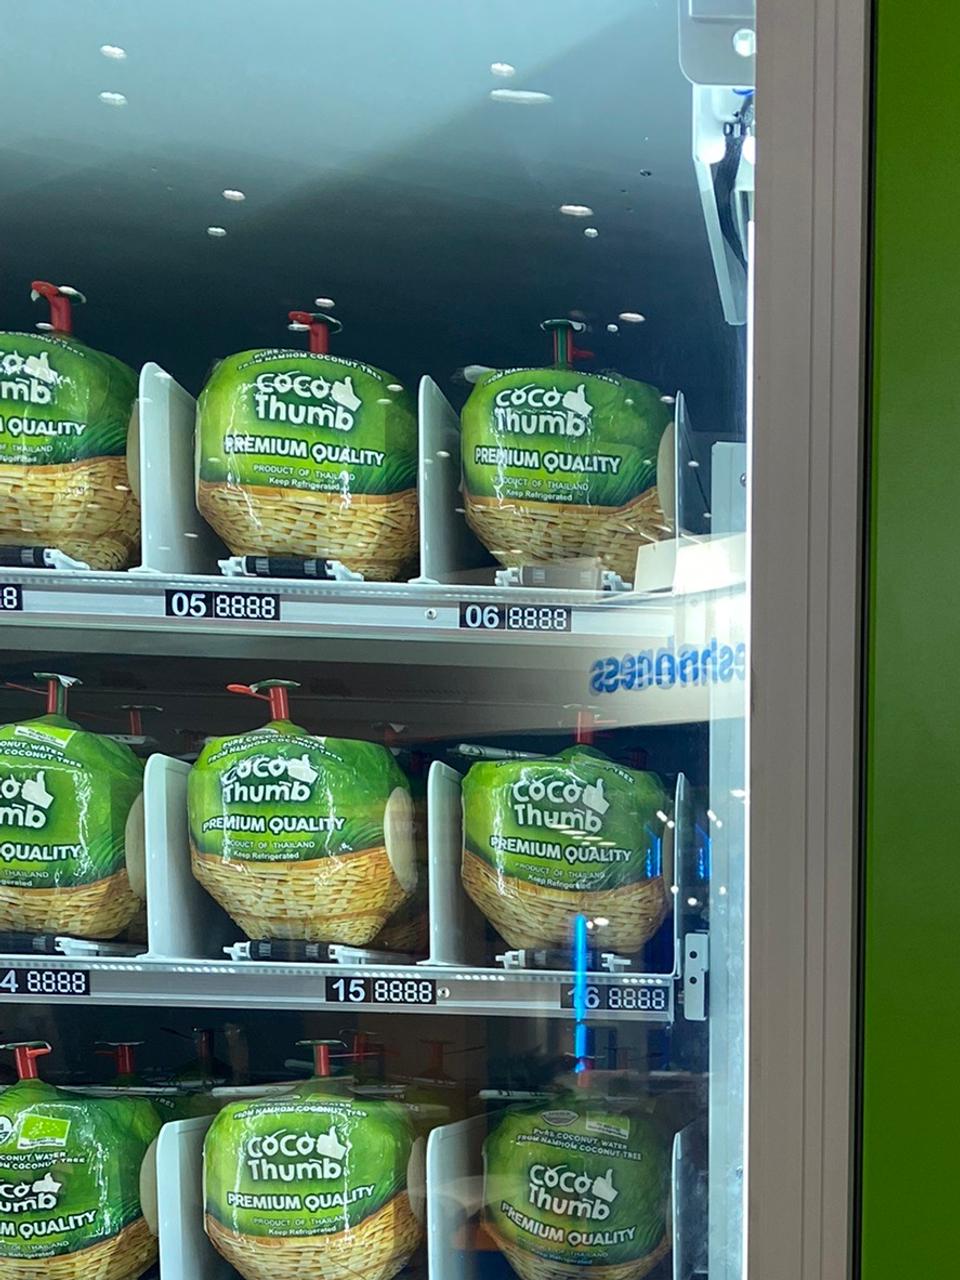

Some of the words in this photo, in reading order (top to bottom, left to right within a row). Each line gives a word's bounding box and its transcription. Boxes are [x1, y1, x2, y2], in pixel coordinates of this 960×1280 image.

[255, 394, 353, 431] Thumb
[495, 407, 585, 436] Thumb
[8, 419, 86, 435] QUALITY
[225, 435, 307, 457] PREMIUM
[312, 445, 384, 465] QUALITY
[475, 447, 538, 467] PREMIUM
[544, 453, 620, 472] QUALITY
[171, 592, 206, 617] 05
[465, 605, 499, 628] 06
[224, 781, 310, 802] Thumb
[203, 815, 265, 832] PREMIUM
[269, 818, 345, 833] QUALITY
[514, 804, 602, 832] Thumb
[3, 843, 81, 860] QUALITY
[491, 837, 560, 859] PREMIUM
[565, 847, 631, 863] QUALITY
[333, 979, 365, 1001] 15
[581, 1145, 620, 1156] COCONUT
[248, 1158, 341, 1181] Thumb
[228, 1193, 300, 1209] PREMIUM
[305, 1186, 374, 1210] QUALITY
[529, 1184, 610, 1220] Thumb
[19, 1210, 96, 1237] QUALITY
[502, 1203, 563, 1241] PREMIUM
[568, 1227, 635, 1245] QUALITY
